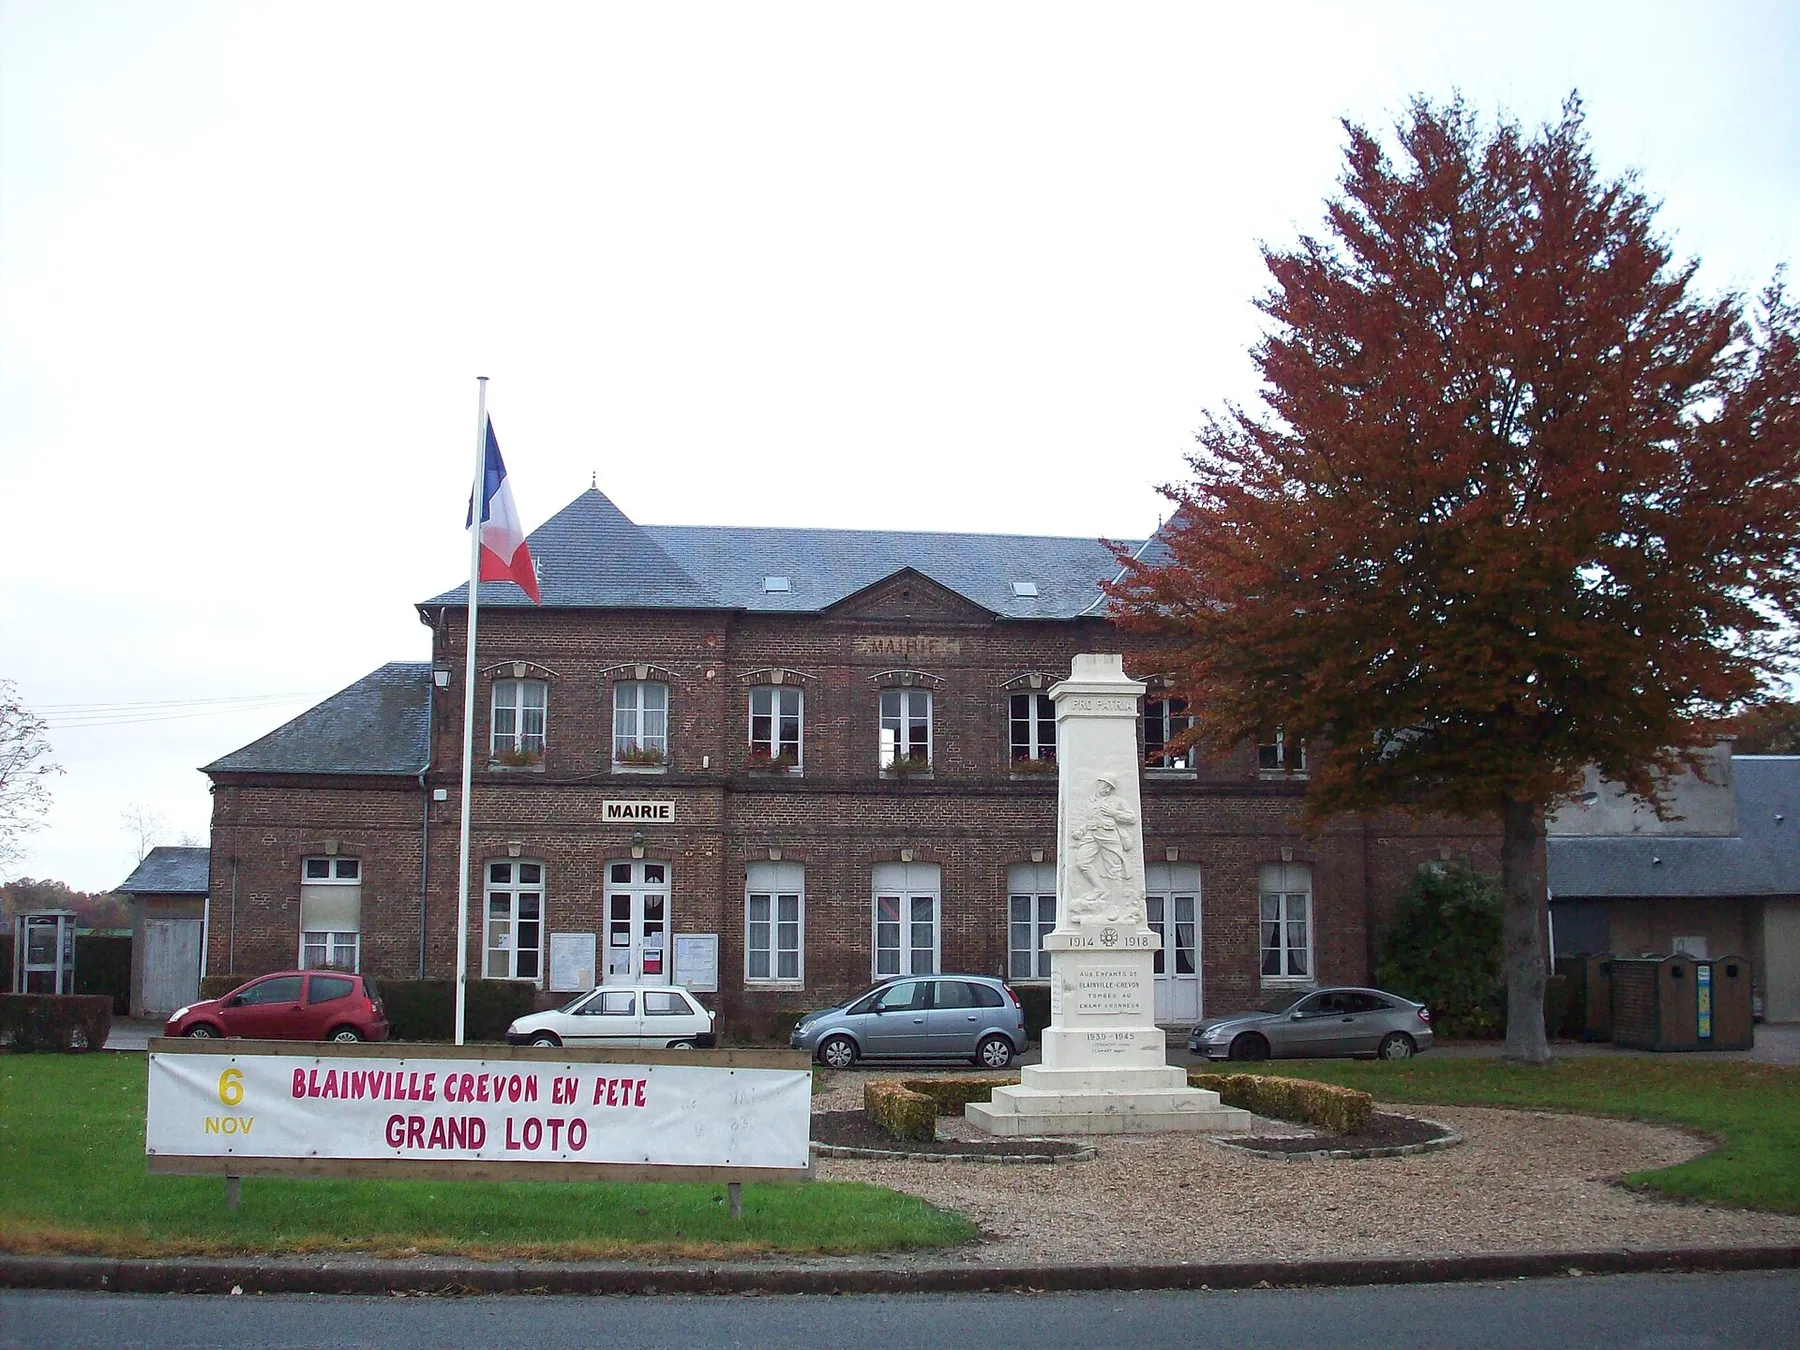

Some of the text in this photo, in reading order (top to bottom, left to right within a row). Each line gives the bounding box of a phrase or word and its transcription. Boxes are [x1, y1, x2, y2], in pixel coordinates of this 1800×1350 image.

[1072, 700, 1133, 711] PRO PATRIA
[607, 804, 670, 819] MAIRIE
[1069, 937, 1094, 947] 1914
[1125, 937, 1149, 947] 1918
[1087, 1033, 1107, 1041] 1939
[1115, 1032, 1135, 1040] 1945
[217, 1067, 244, 1107] 6
[292, 1068, 647, 1107] BLAINVILLE CREVON EN FETE
[205, 1117, 254, 1135] NOV
[386, 1114, 588, 1151] GRAND LOTO
